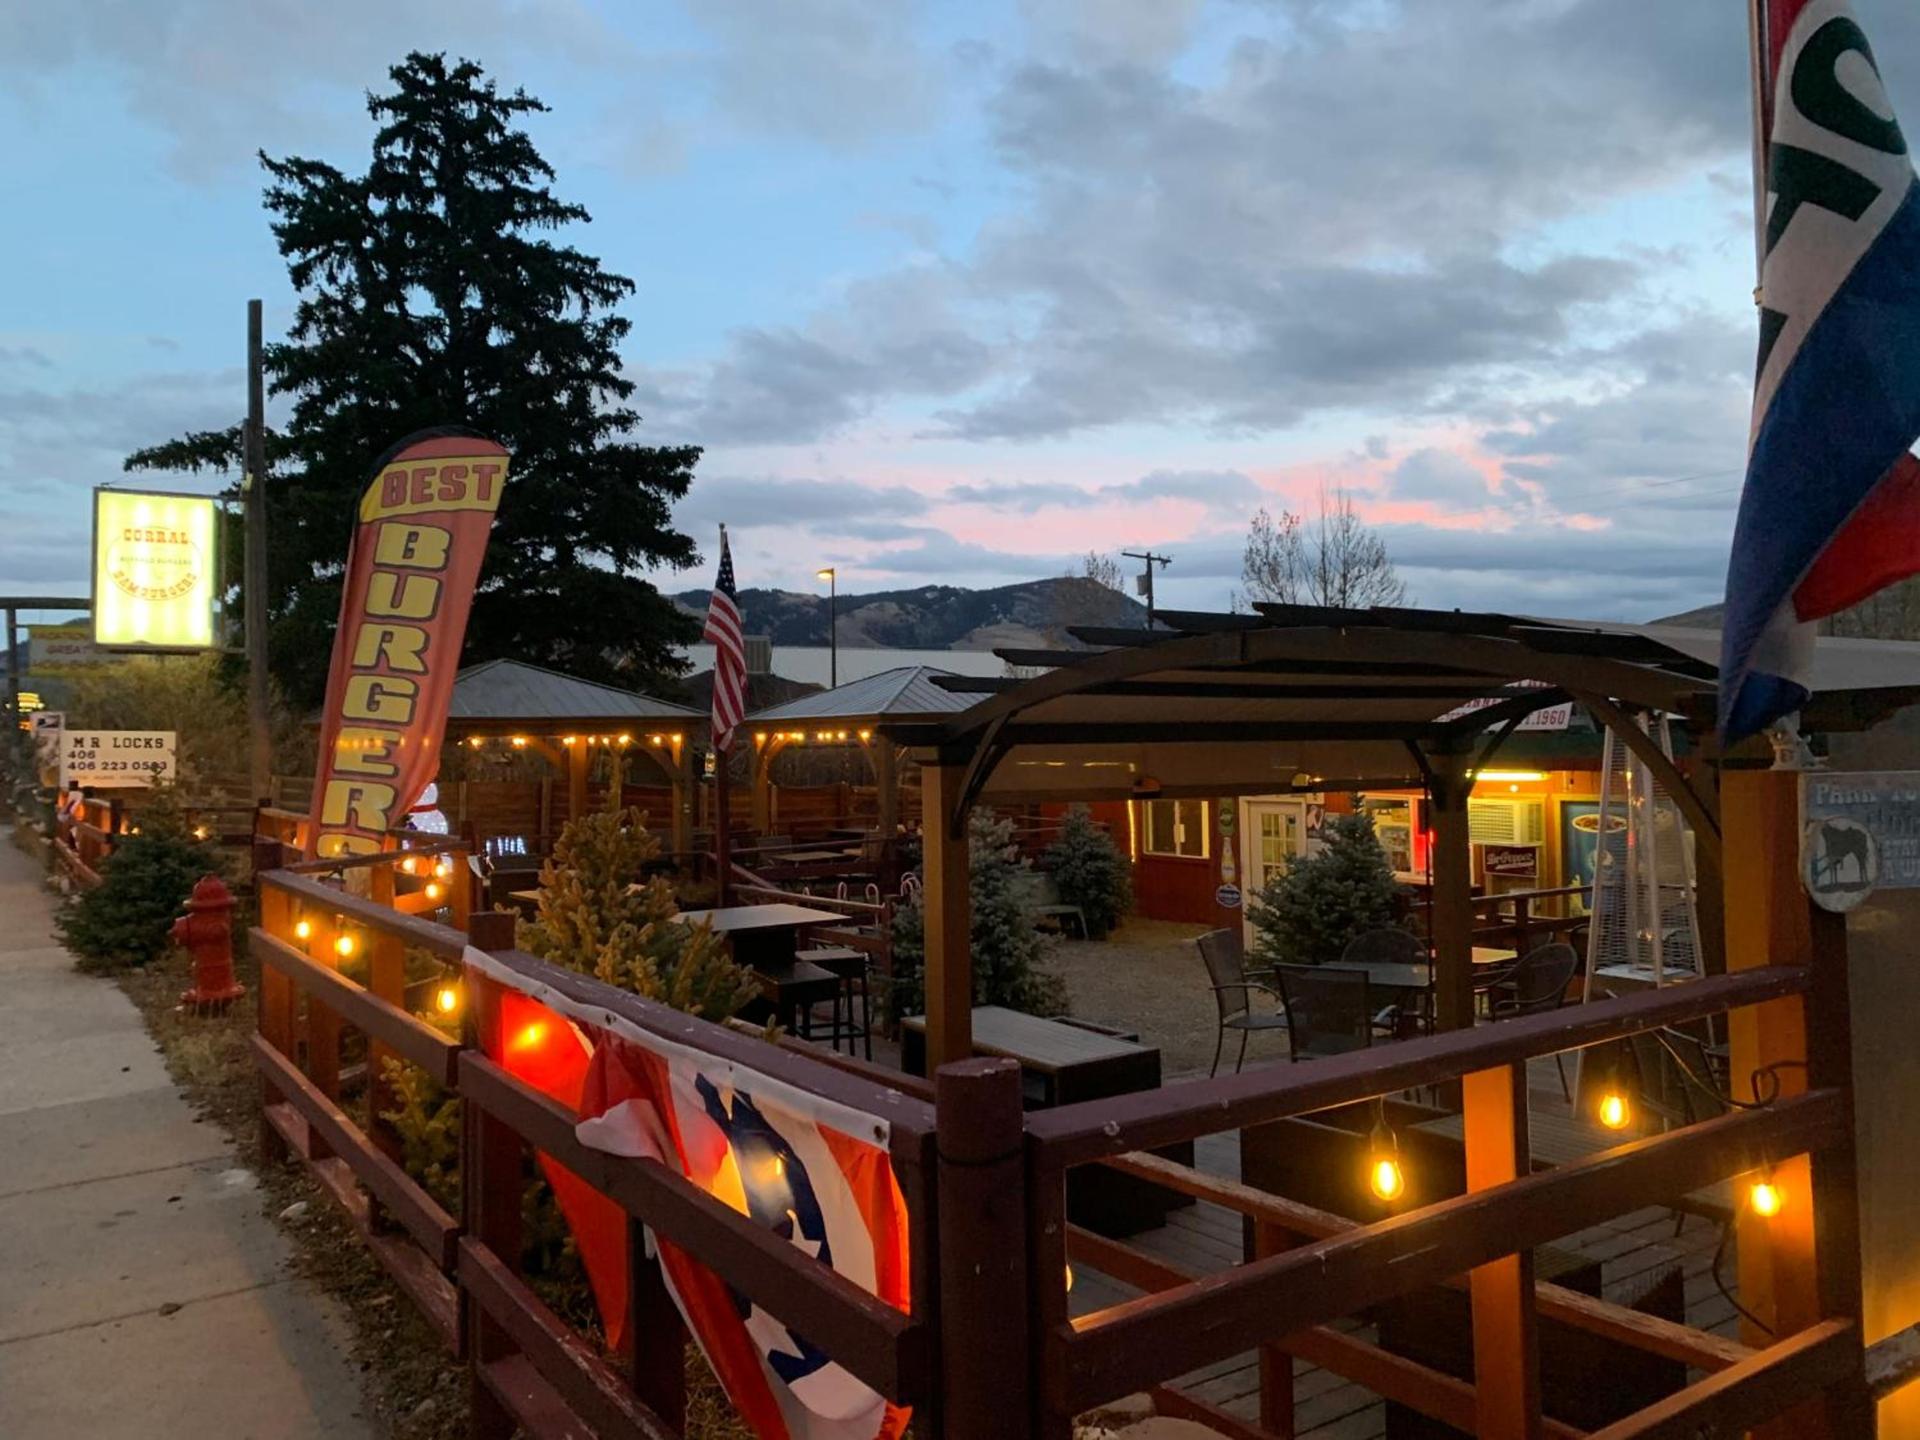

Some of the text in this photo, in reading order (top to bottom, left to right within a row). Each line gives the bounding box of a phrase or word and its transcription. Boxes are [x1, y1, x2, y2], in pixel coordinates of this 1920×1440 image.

[380, 464, 501, 508] BEST
[124, 528, 189, 545] CORRAL
[113, 737, 164, 748] LOCKS
[68, 751, 96, 759] 406
[68, 762, 96, 770] 406
[101, 762, 127, 770] 223
